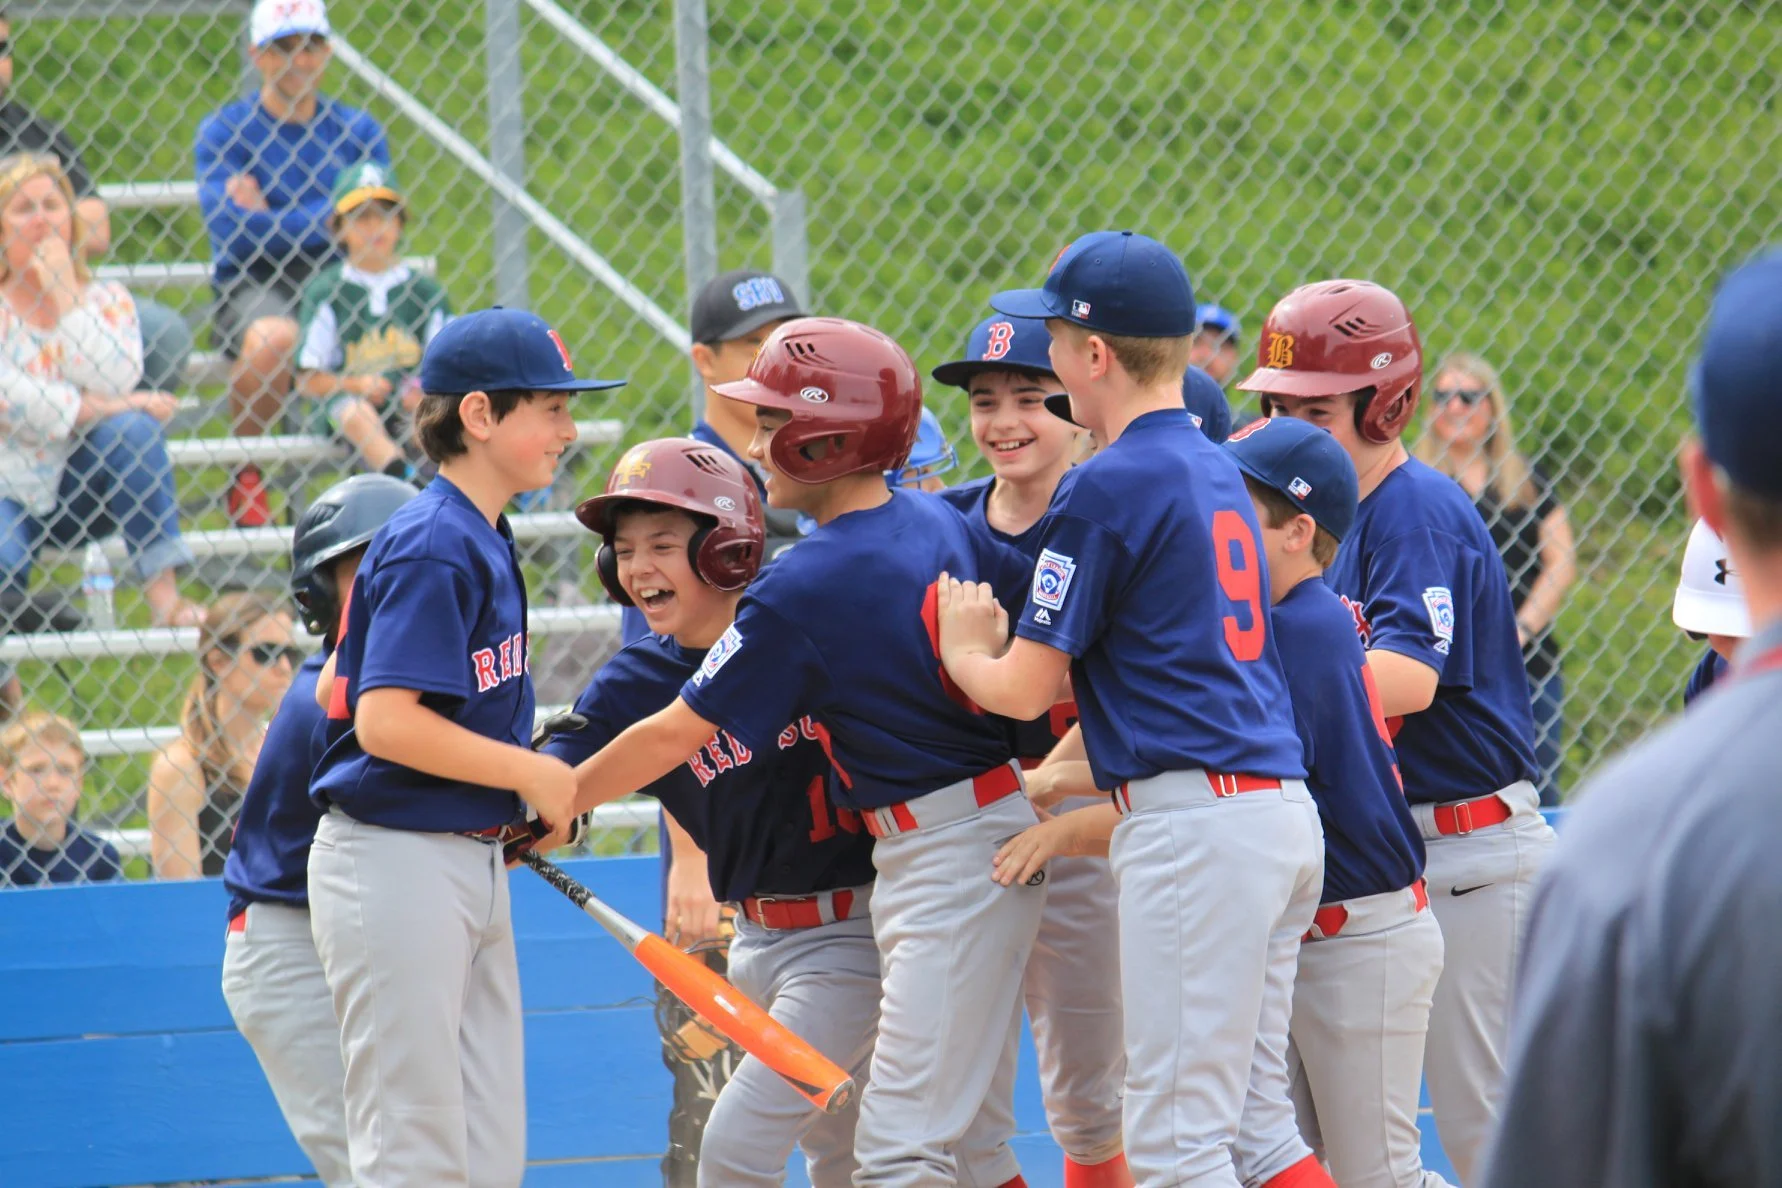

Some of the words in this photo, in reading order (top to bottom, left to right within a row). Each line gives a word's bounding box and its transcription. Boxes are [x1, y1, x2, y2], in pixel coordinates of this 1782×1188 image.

[982, 321, 1015, 361] B
[1267, 332, 1295, 369] B
[1212, 510, 1266, 661] 9
[687, 729, 753, 788] RED
